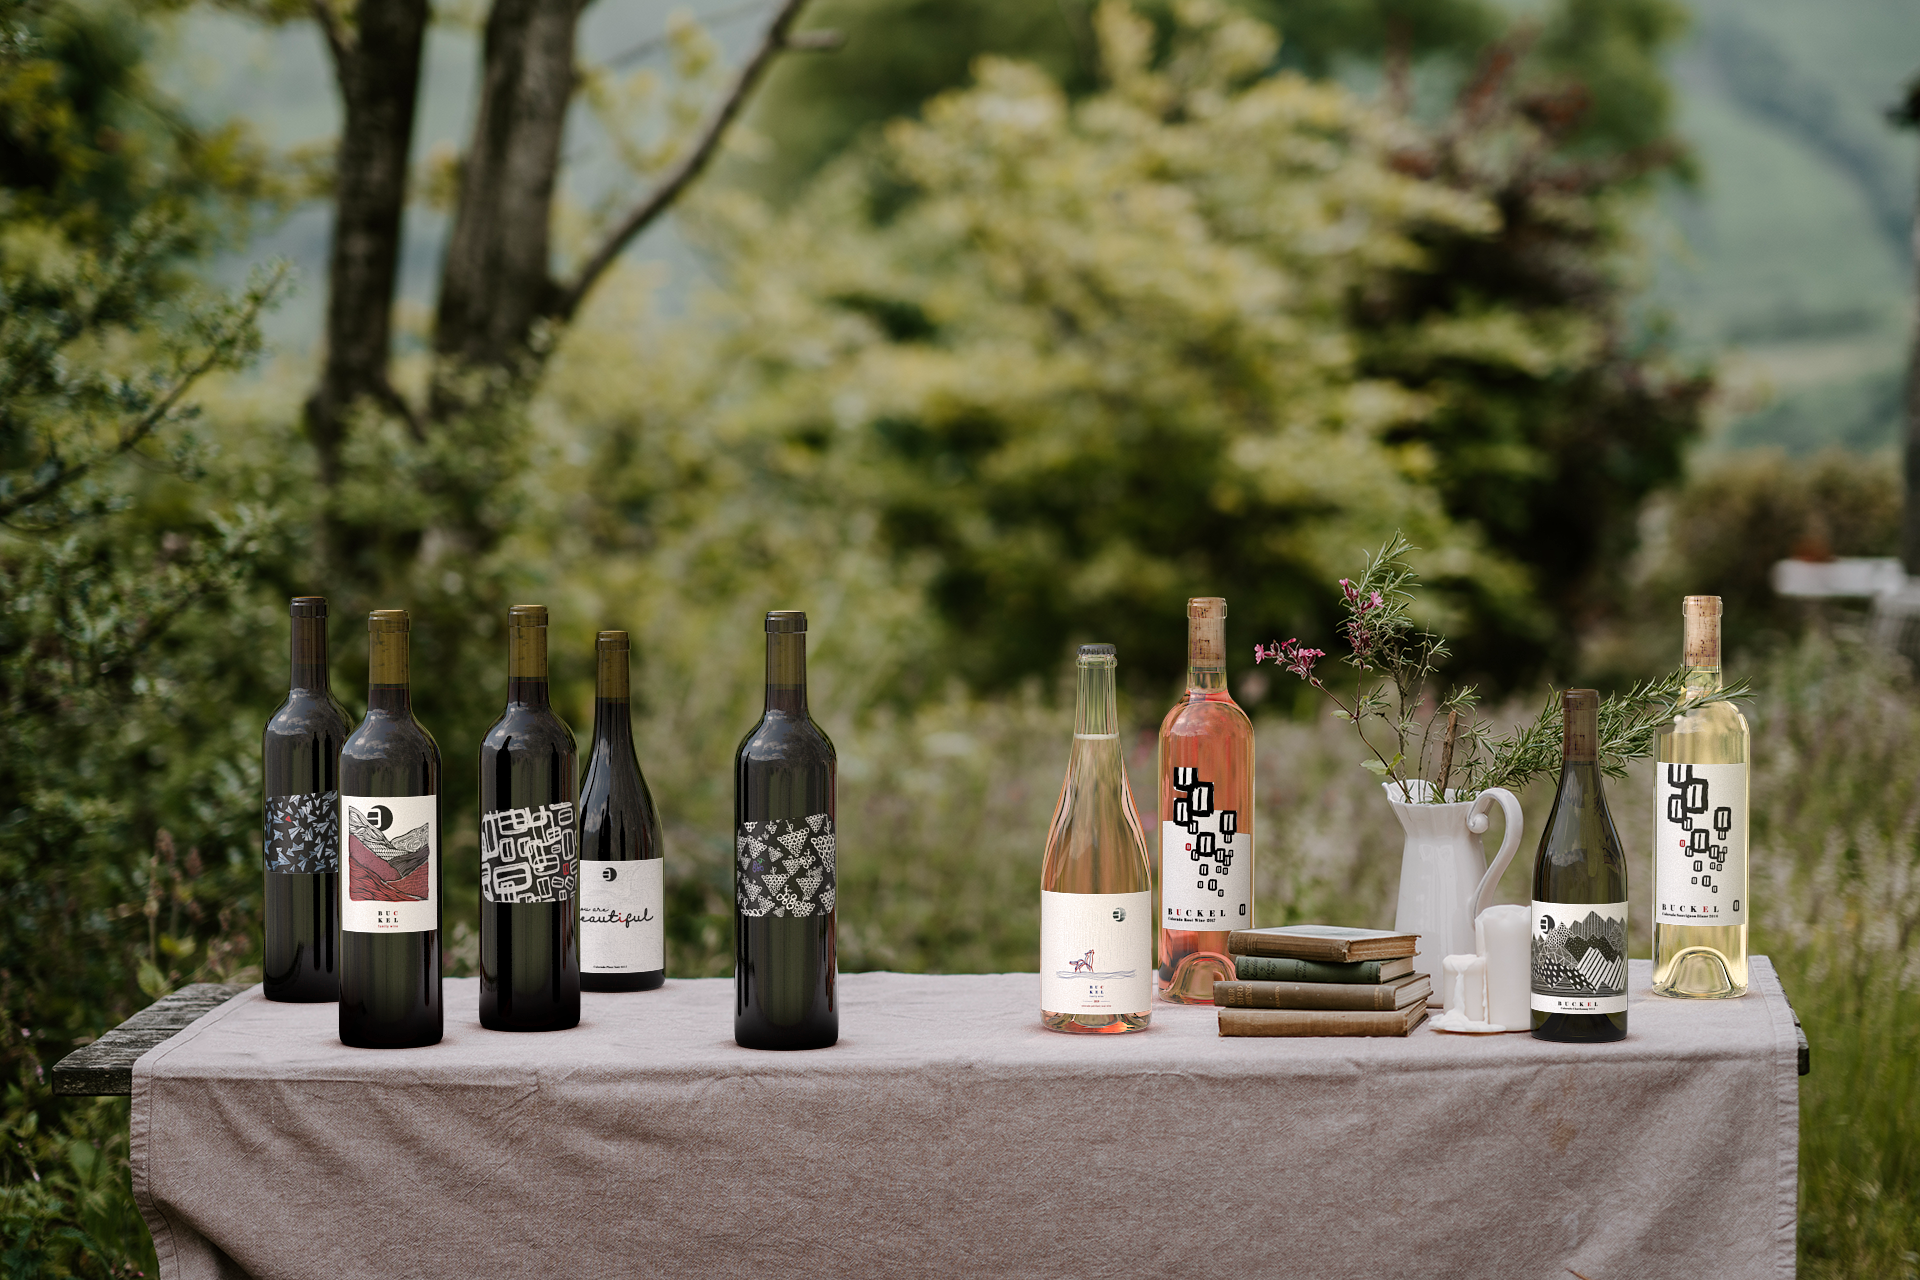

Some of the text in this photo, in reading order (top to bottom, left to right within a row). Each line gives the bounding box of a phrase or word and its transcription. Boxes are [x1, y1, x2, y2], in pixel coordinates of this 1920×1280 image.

[1168, 908, 1226, 917] BUCKEL
[1662, 903, 1719, 913] BUCKEL
[580, 908, 654, 928] eautiful
[1237, 985, 1245, 1005] BIRD
